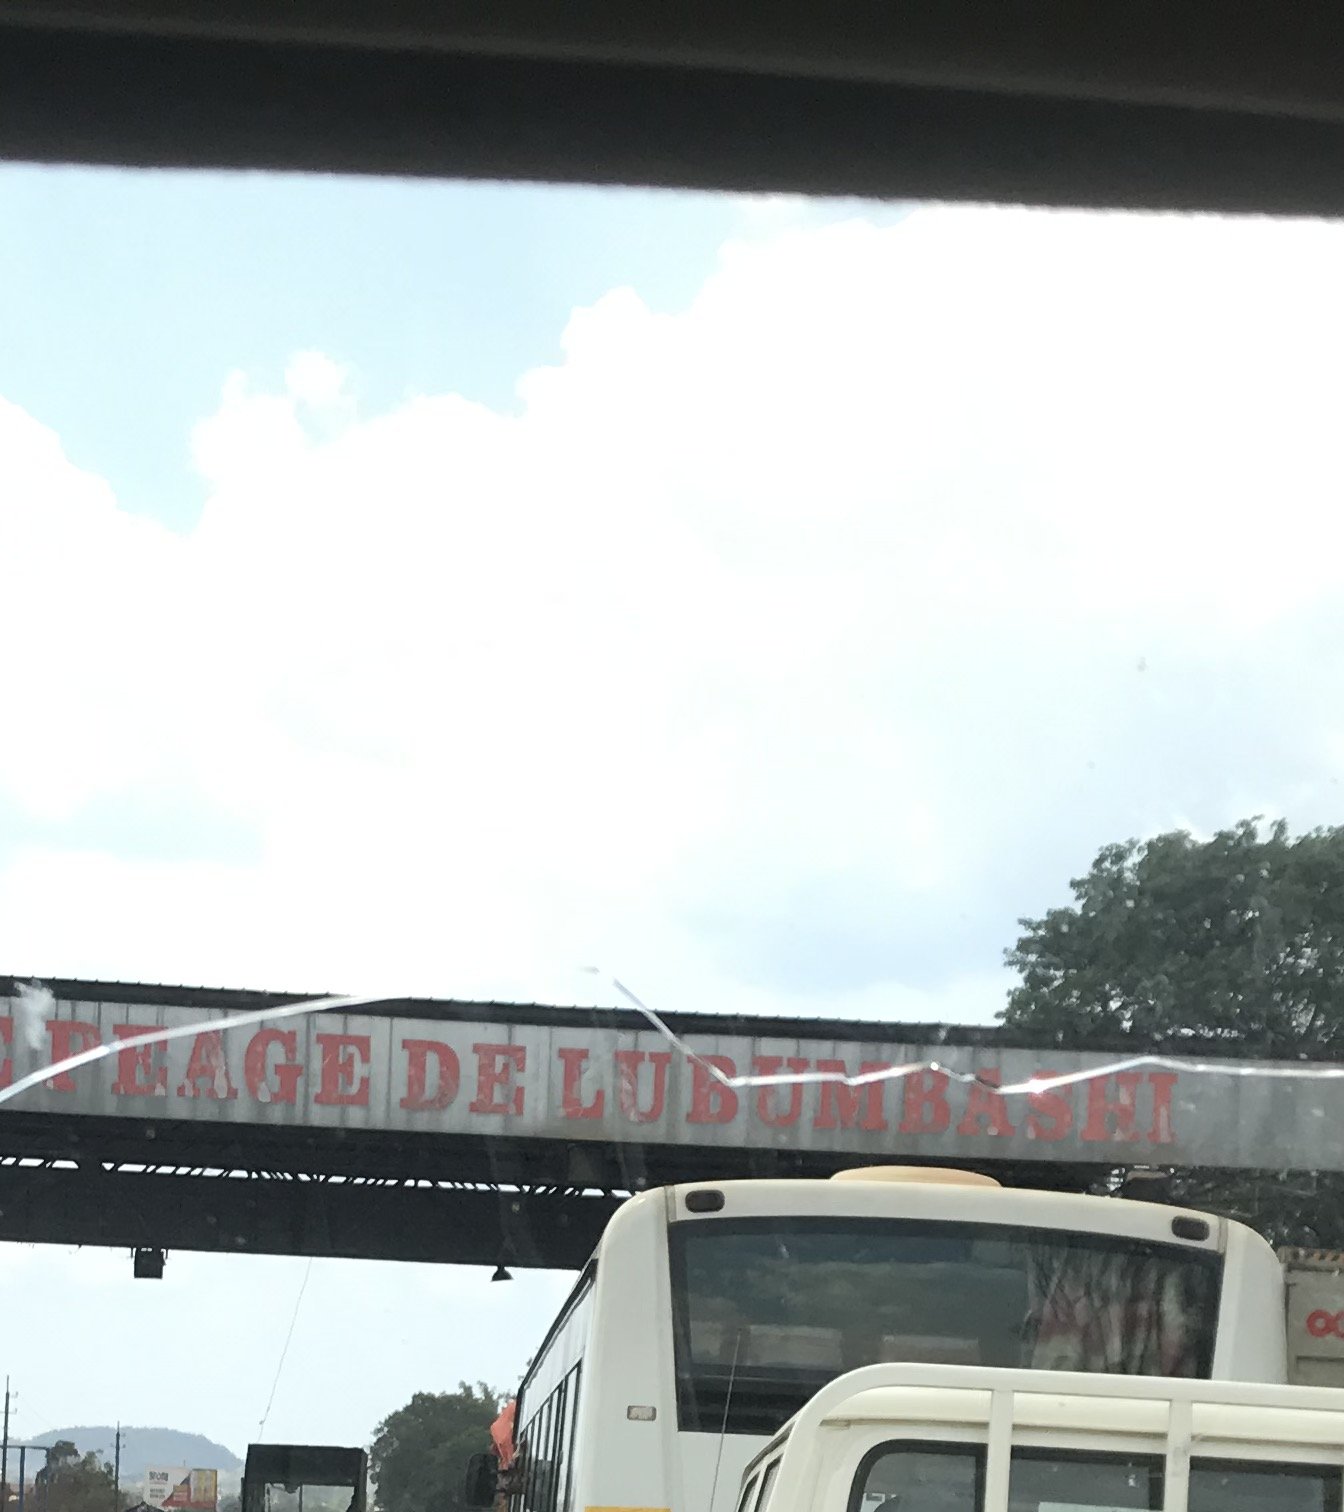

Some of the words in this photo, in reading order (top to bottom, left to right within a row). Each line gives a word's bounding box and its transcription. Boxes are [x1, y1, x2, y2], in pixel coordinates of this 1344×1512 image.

[45, 1019, 372, 1107] PEAGE
[399, 1036, 527, 1118] DE
[556, 1045, 1181, 1147] LUBUMBASHI
